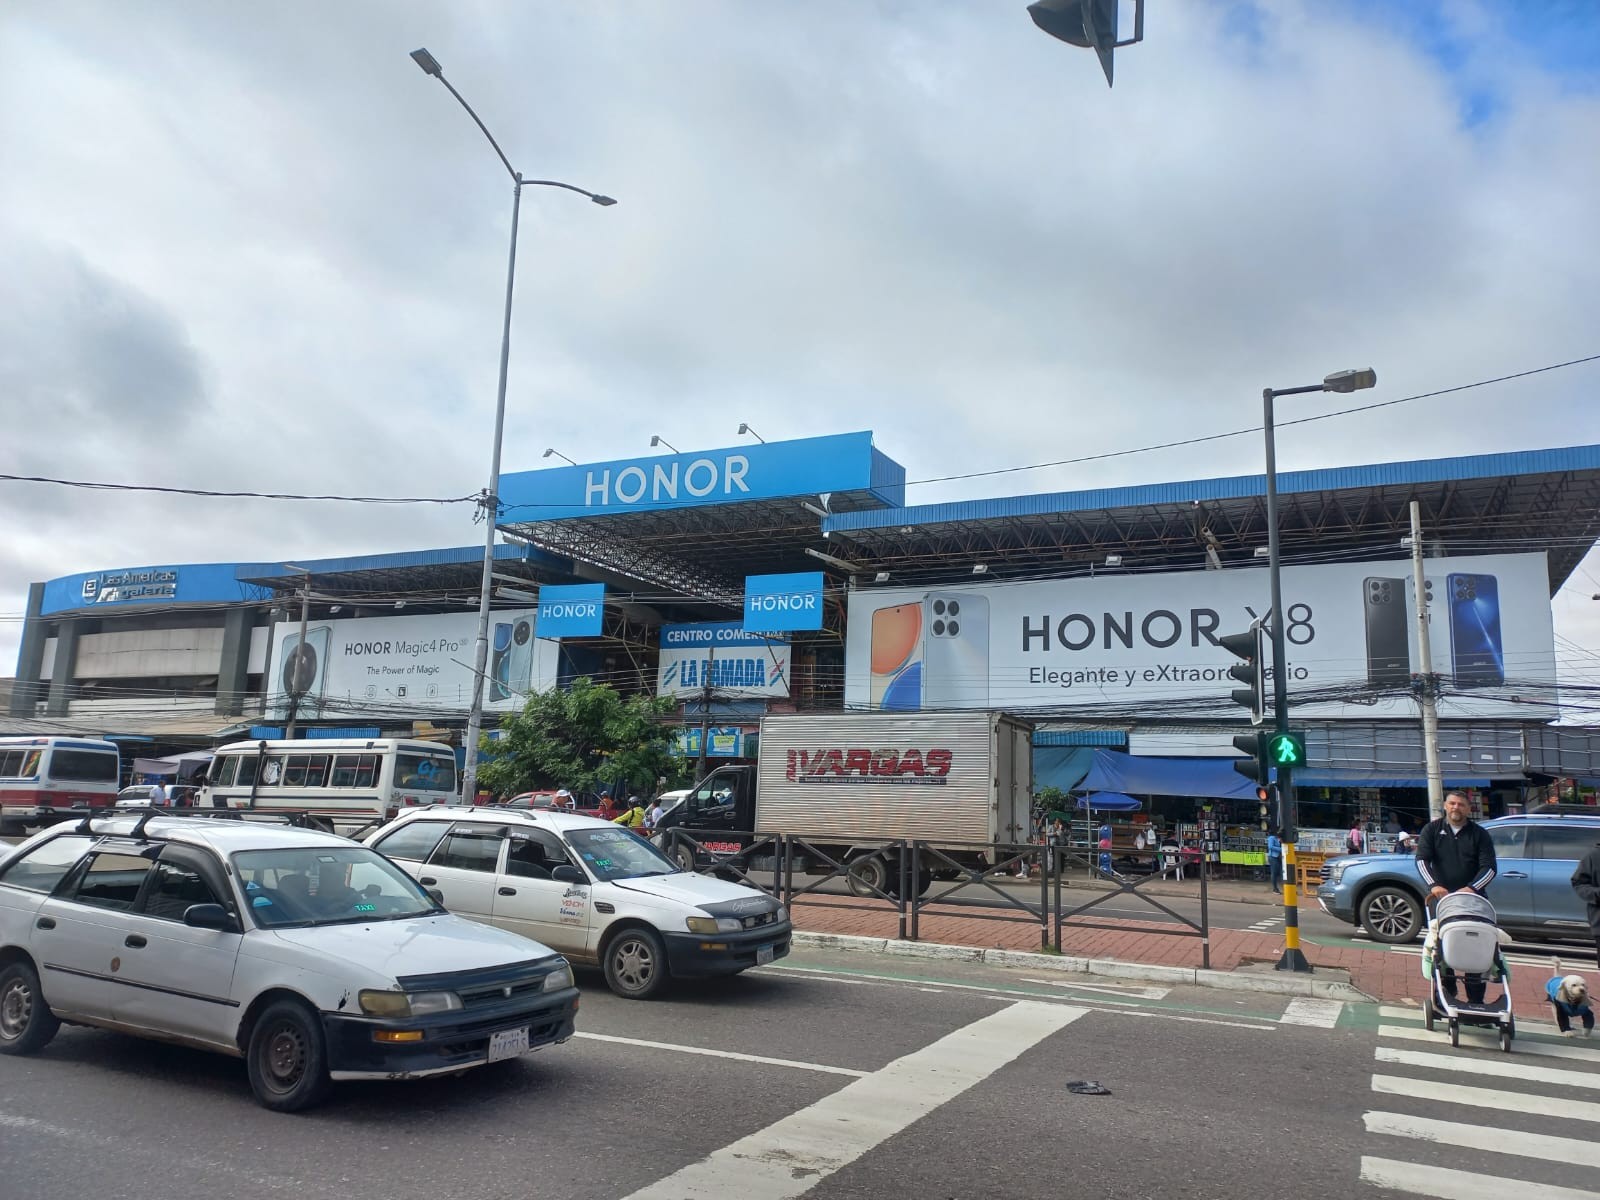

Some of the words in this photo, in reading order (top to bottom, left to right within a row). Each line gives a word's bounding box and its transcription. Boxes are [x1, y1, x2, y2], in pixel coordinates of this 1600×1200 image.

[585, 455, 750, 507] HONOR
[542, 604, 596, 618] HONOR
[751, 595, 815, 611] HONOR
[667, 630, 713, 642] CENTRO
[1023, 608, 1222, 652] HONOR
[345, 641, 391, 655] HONOR
[395, 640, 436, 657] Magic4
[439, 639, 459, 652] Pro
[367, 666, 380, 675] The
[382, 666, 405, 675] Power
[407, 665, 415, 674] of
[416, 665, 440, 676] Magic
[680, 660, 698, 687] LA
[1030, 666, 1119, 688] Elegante
[1125, 670, 1137, 687] y
[799, 749, 953, 777] VARGAS
[354, 904, 377, 912] TAXI
